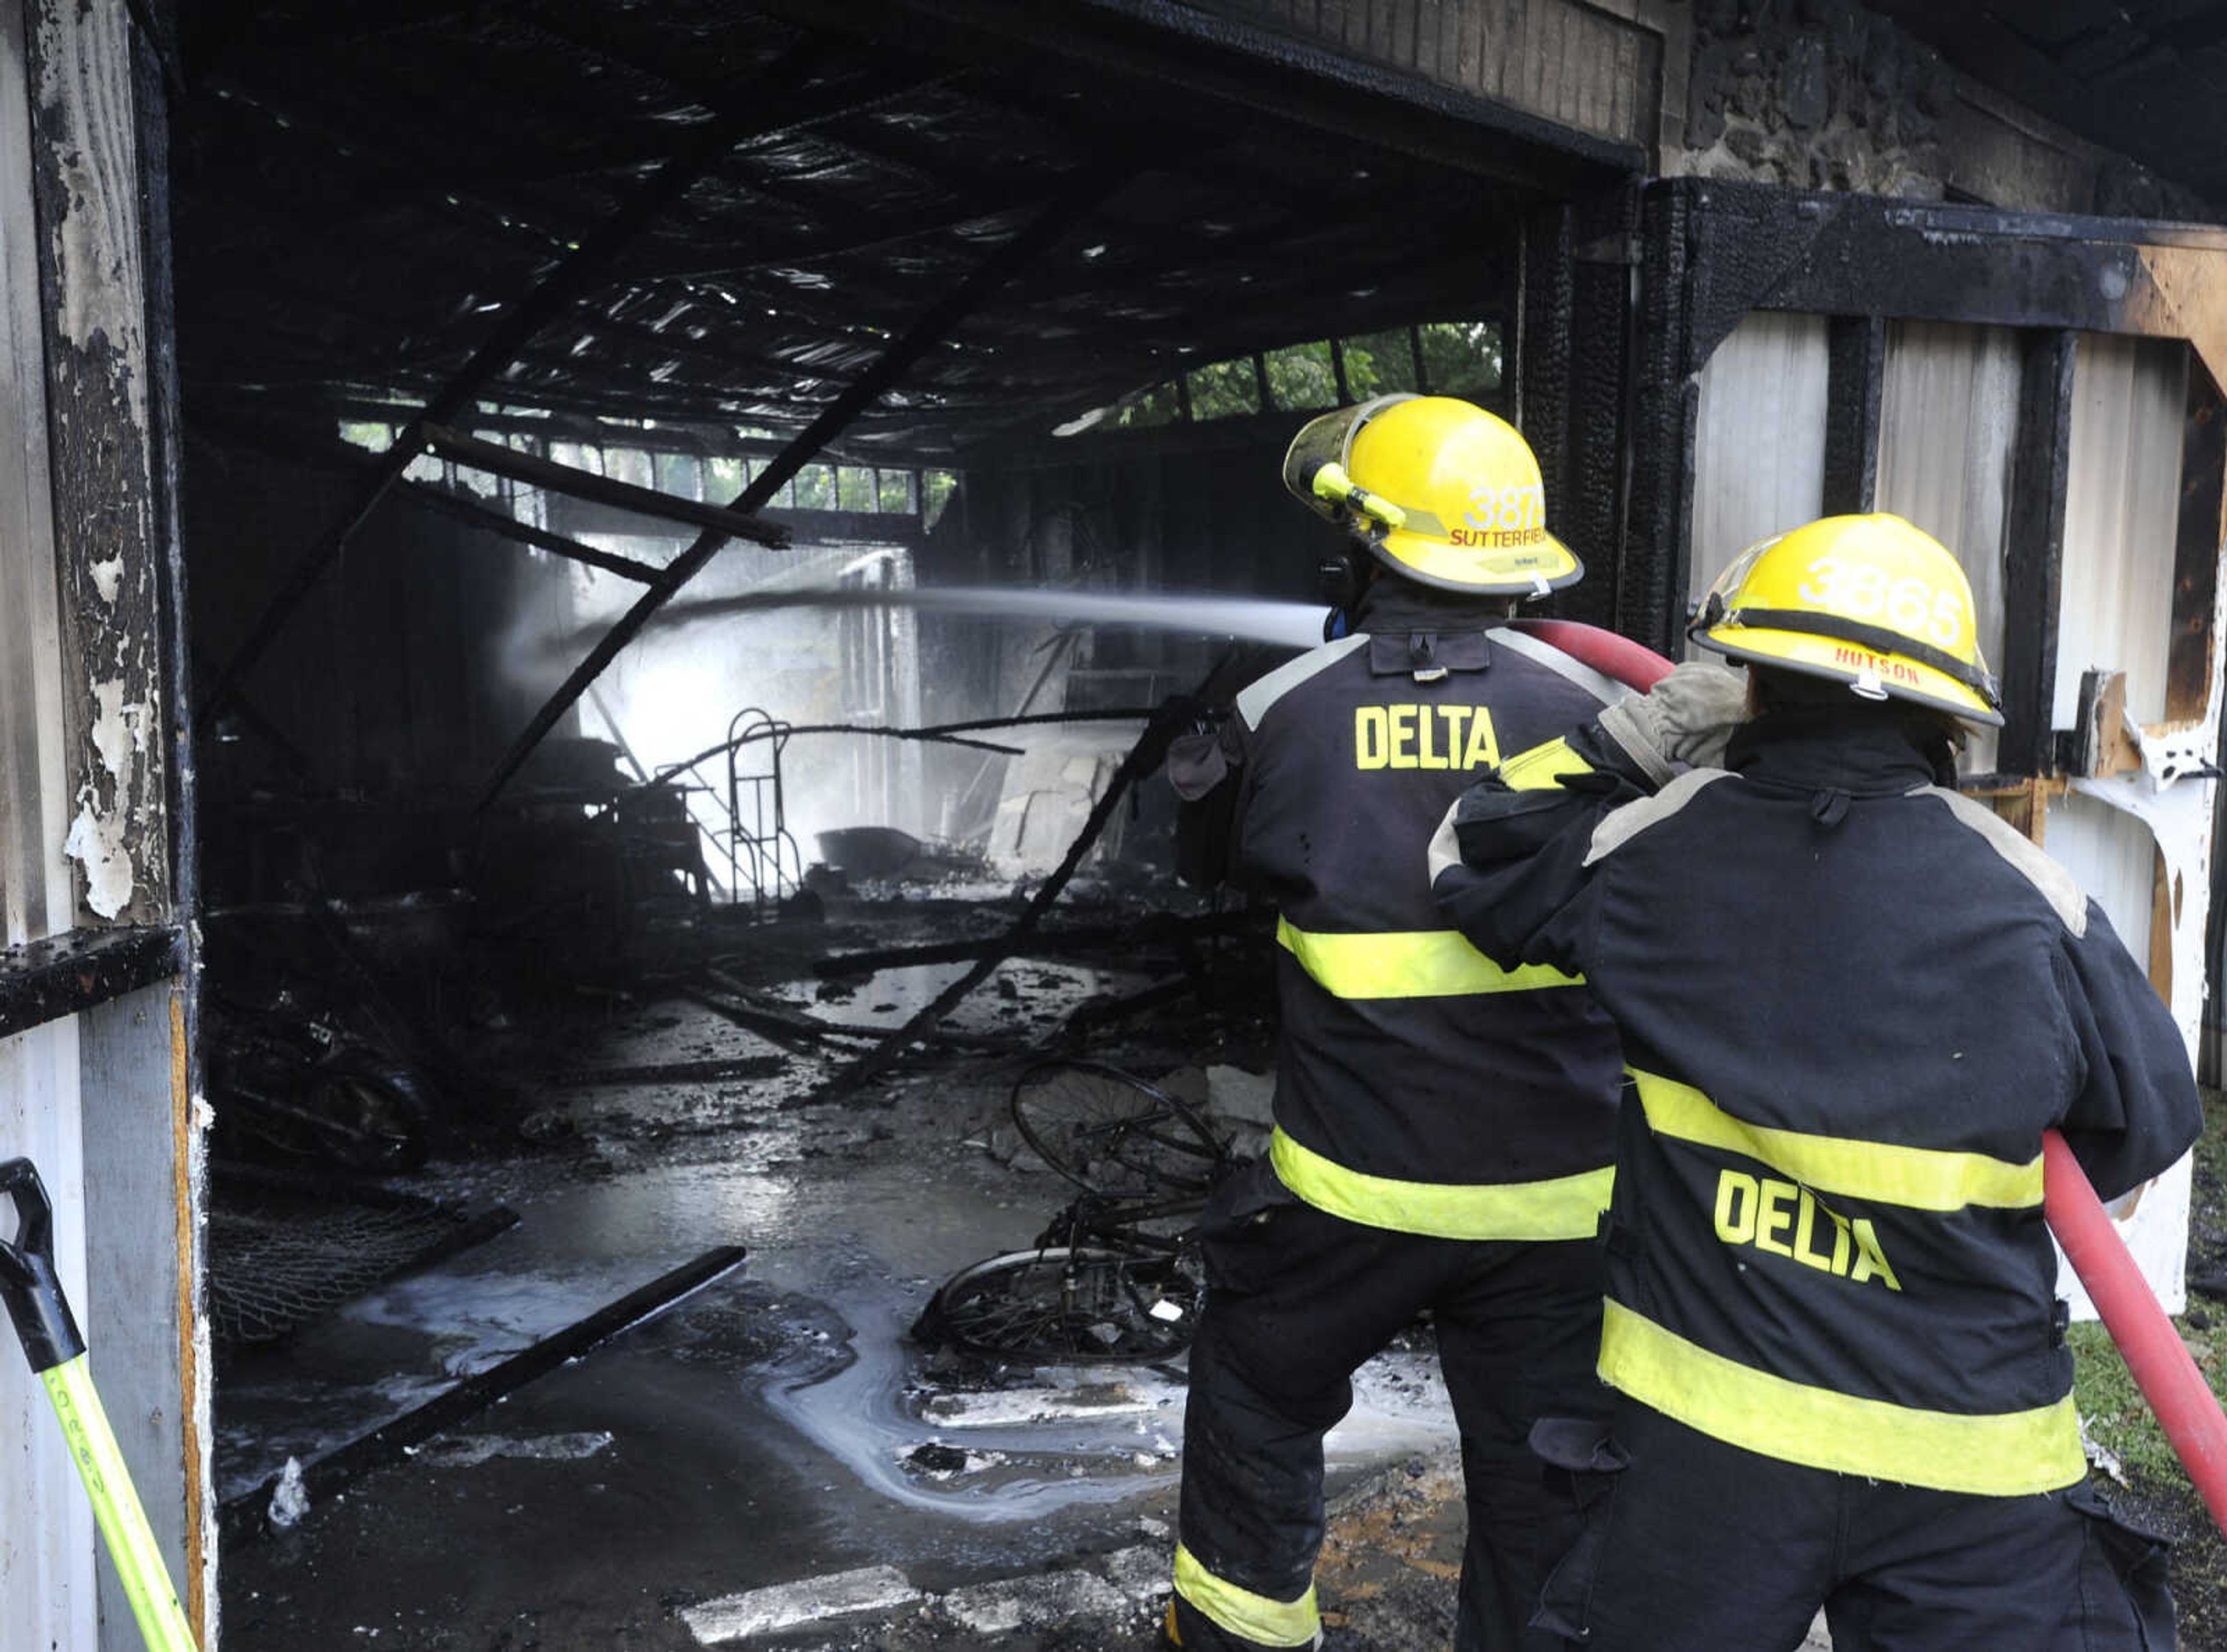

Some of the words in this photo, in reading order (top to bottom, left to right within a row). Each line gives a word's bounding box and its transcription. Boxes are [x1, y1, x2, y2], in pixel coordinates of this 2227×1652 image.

[1464, 486, 1545, 530] 387
[1798, 557, 1961, 646] 3865
[1836, 648, 1919, 685] HUTSON
[1355, 704, 1500, 770] DELTA
[1715, 1169, 1902, 1291] DELTA
